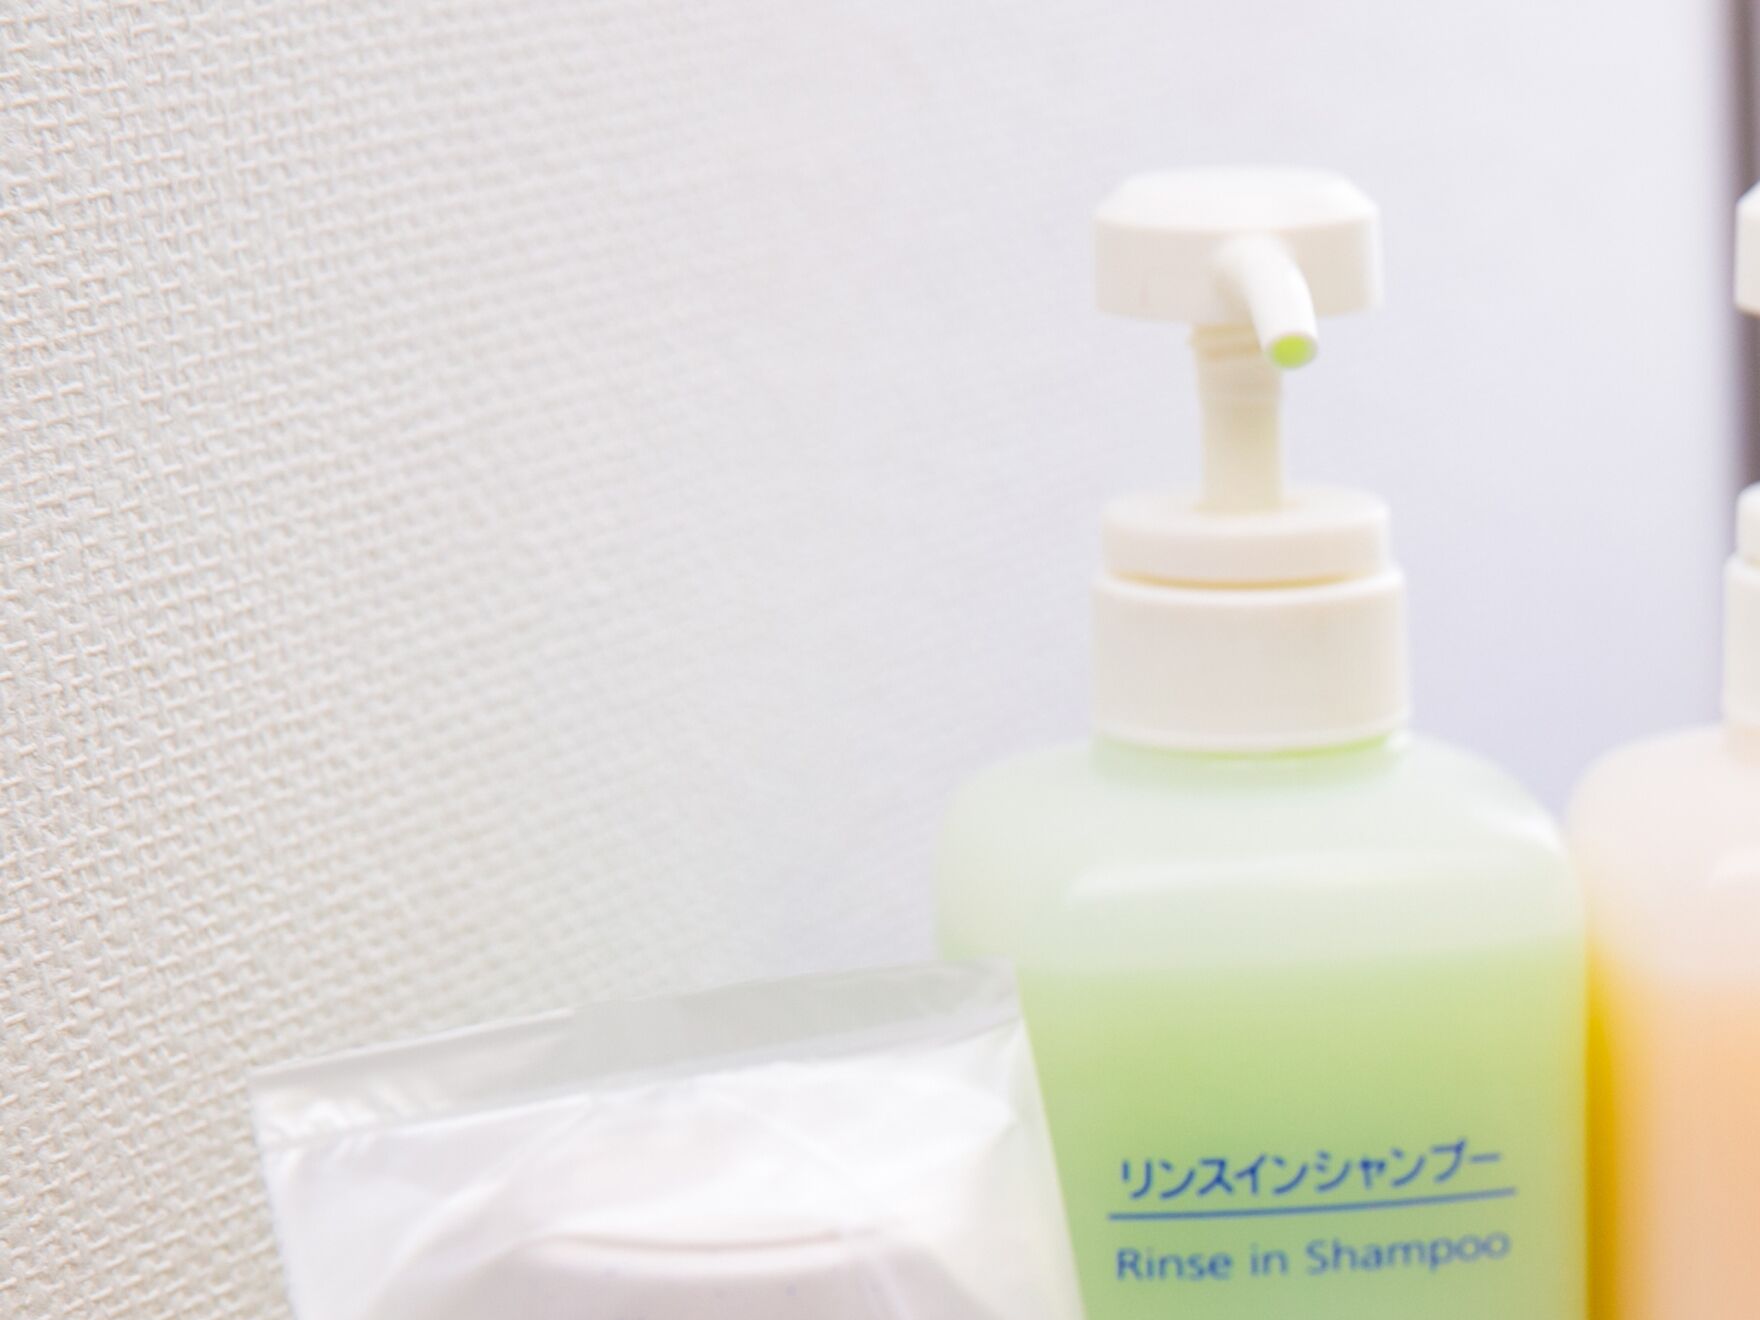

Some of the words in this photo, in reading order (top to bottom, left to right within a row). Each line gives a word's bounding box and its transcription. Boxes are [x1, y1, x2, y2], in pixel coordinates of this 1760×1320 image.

[1121, 1136, 1501, 1199] リンスインシャンプー
[1116, 1246, 1234, 1281] Rinse
[1250, 1242, 1289, 1276] in
[1305, 1231, 1511, 1276] Shampoo
